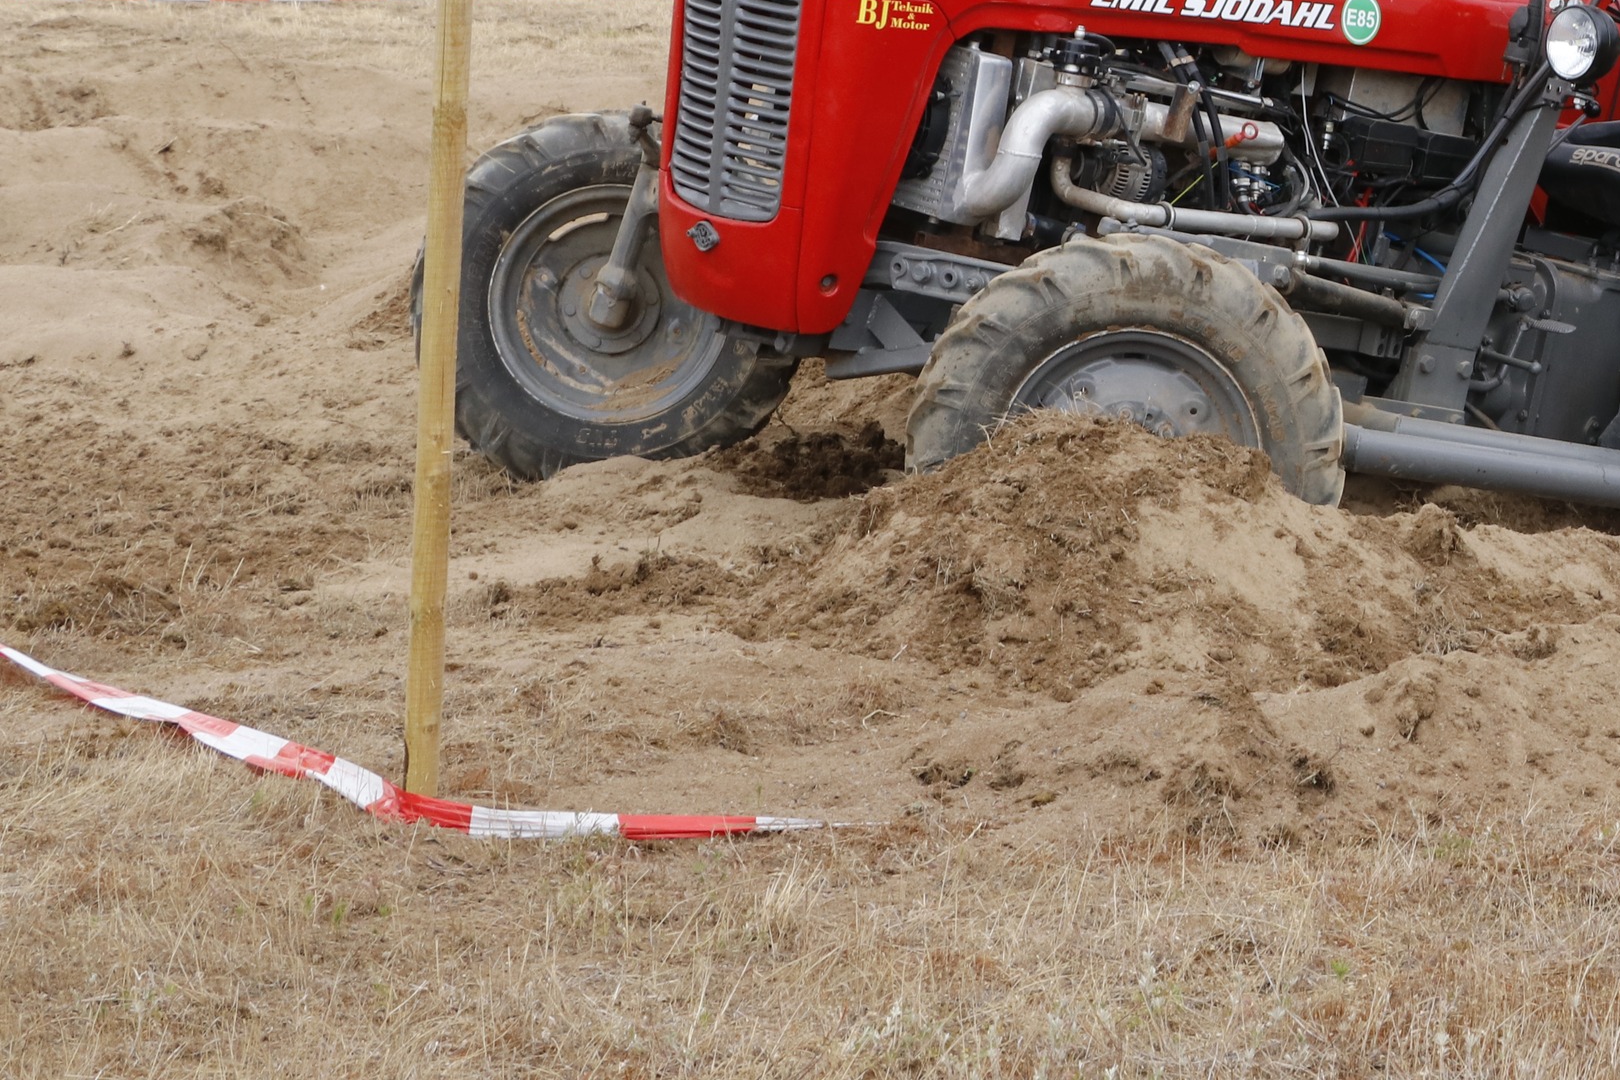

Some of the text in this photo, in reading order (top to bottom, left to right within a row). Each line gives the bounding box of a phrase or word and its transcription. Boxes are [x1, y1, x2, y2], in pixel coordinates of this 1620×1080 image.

[891, 0, 934, 14] Teknik
[907, 12, 916, 20] &
[1346, 8, 1376, 29] E85
[890, 17, 930, 31] Motor
